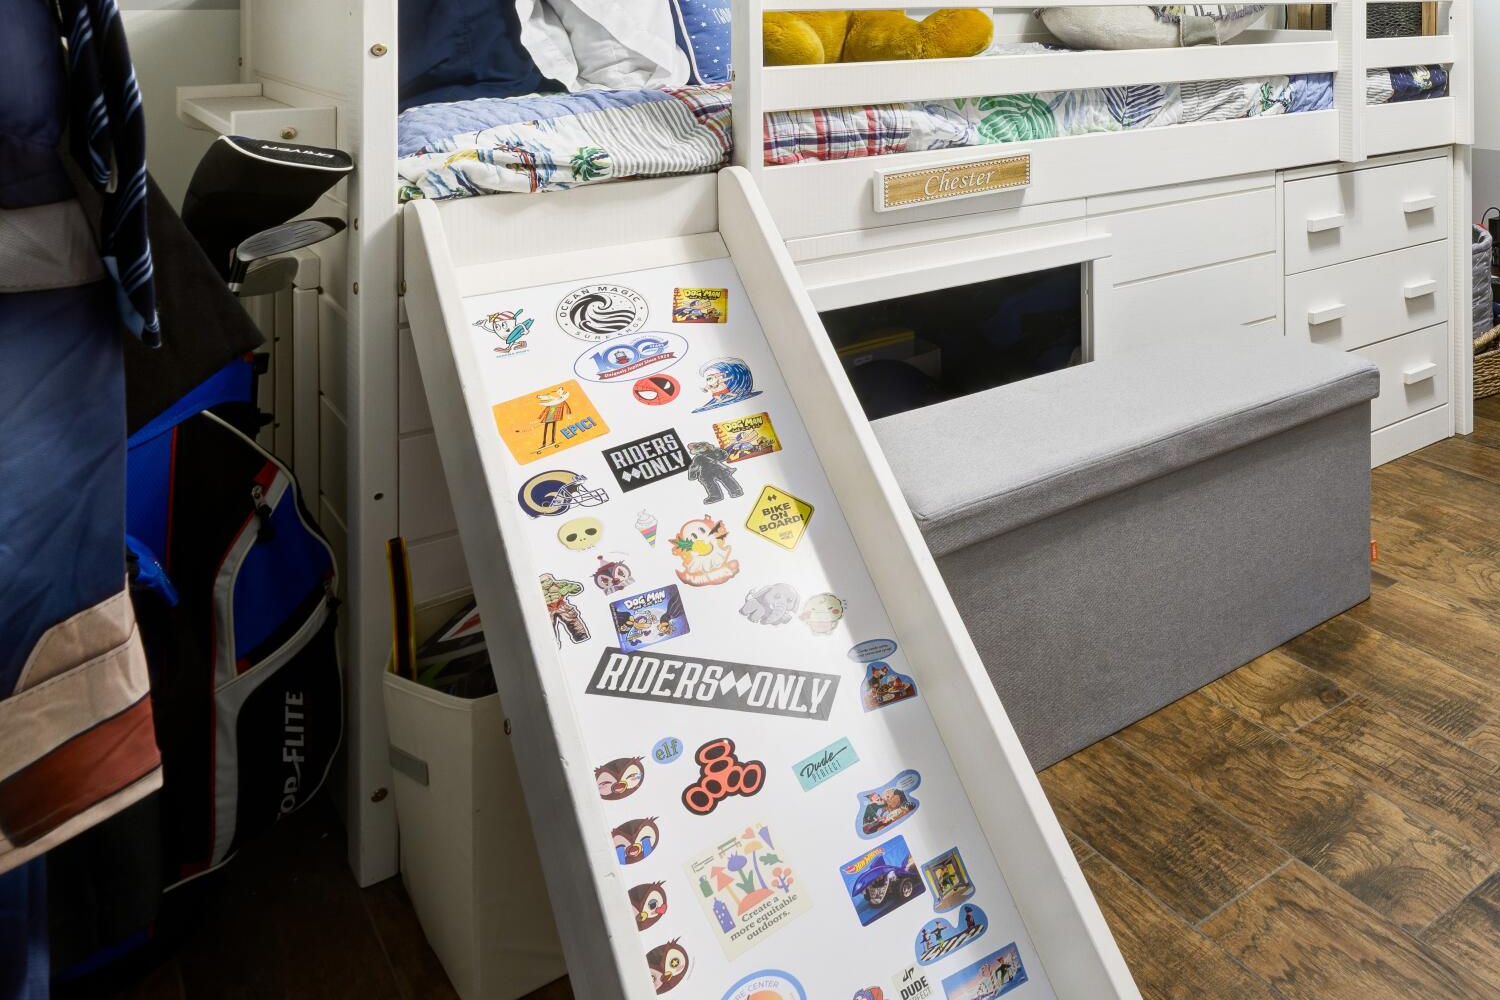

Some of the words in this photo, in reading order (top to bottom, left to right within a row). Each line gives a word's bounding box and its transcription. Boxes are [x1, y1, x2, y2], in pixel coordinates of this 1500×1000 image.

[923, 170, 996, 197] Chester
[559, 288, 590, 318] OCEAN
[597, 286, 642, 303] MAGIC
[560, 415, 597, 440] EPIC!
[609, 433, 680, 470] RIDERS
[638, 449, 686, 480] ONLY
[758, 513, 806, 533] BOARD!
[761, 502, 792, 517] BIKE
[769, 510, 789, 521] ON
[623, 594, 646, 610] DOG
[646, 589, 666, 603] MAN
[596, 652, 724, 702] RIDERS
[747, 671, 832, 714] ONLY
[282, 690, 305, 763] FLITE
[654, 737, 680, 761] elf
[799, 745, 848, 778] Dude
[811, 759, 842, 783] PERFECT
[730, 922, 756, 941] more
[756, 893, 798, 929] equitable
[741, 899, 772, 922] Create
[770, 895, 780, 903] a
[746, 909, 791, 941] outdoors.
[747, 979, 780, 992] CENTER
[900, 975, 929, 1000] DUDE
